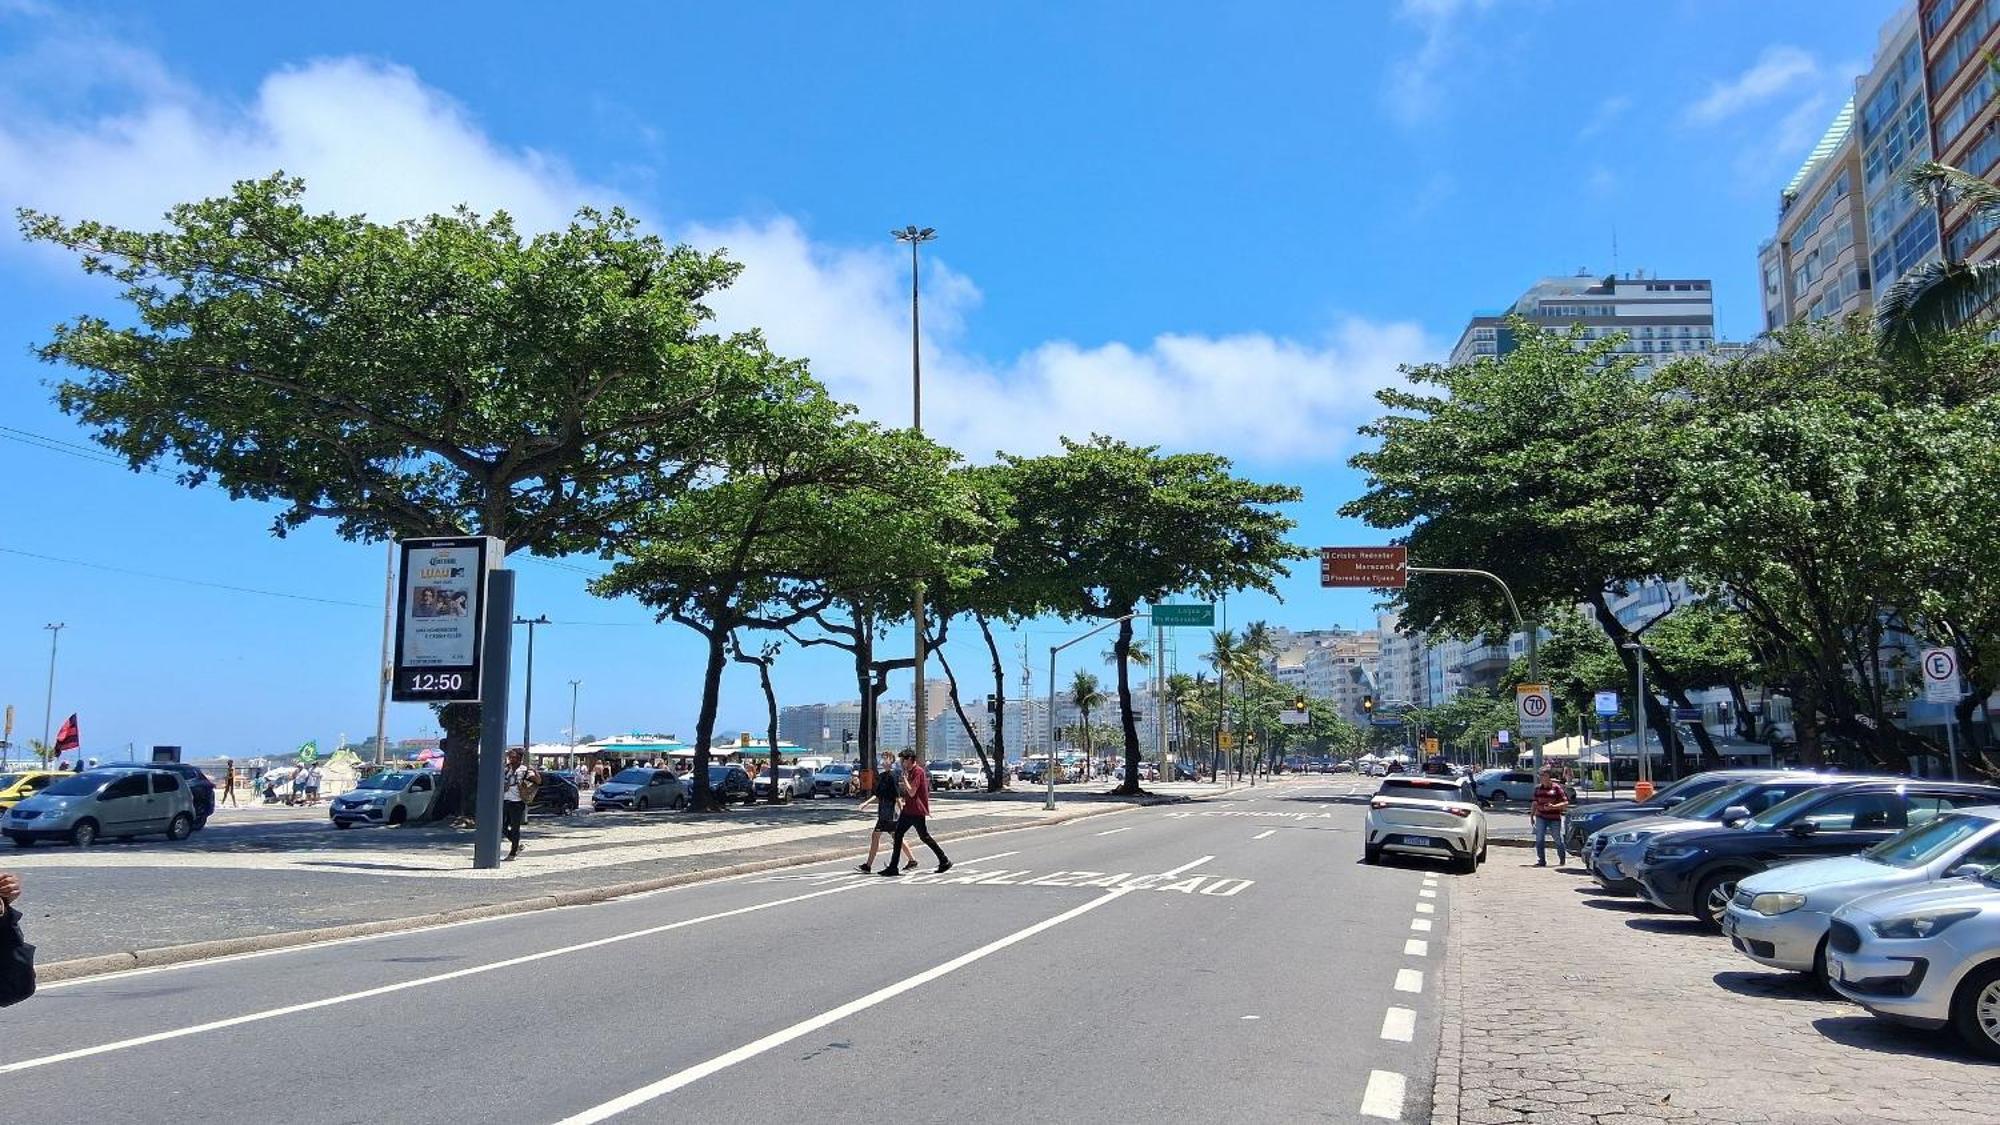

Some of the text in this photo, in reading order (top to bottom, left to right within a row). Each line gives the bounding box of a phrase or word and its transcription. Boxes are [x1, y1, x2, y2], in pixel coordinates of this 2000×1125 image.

[1934, 657, 1946, 674] E
[411, 674, 462, 690] 12:50
[1528, 699, 1542, 711] 70
